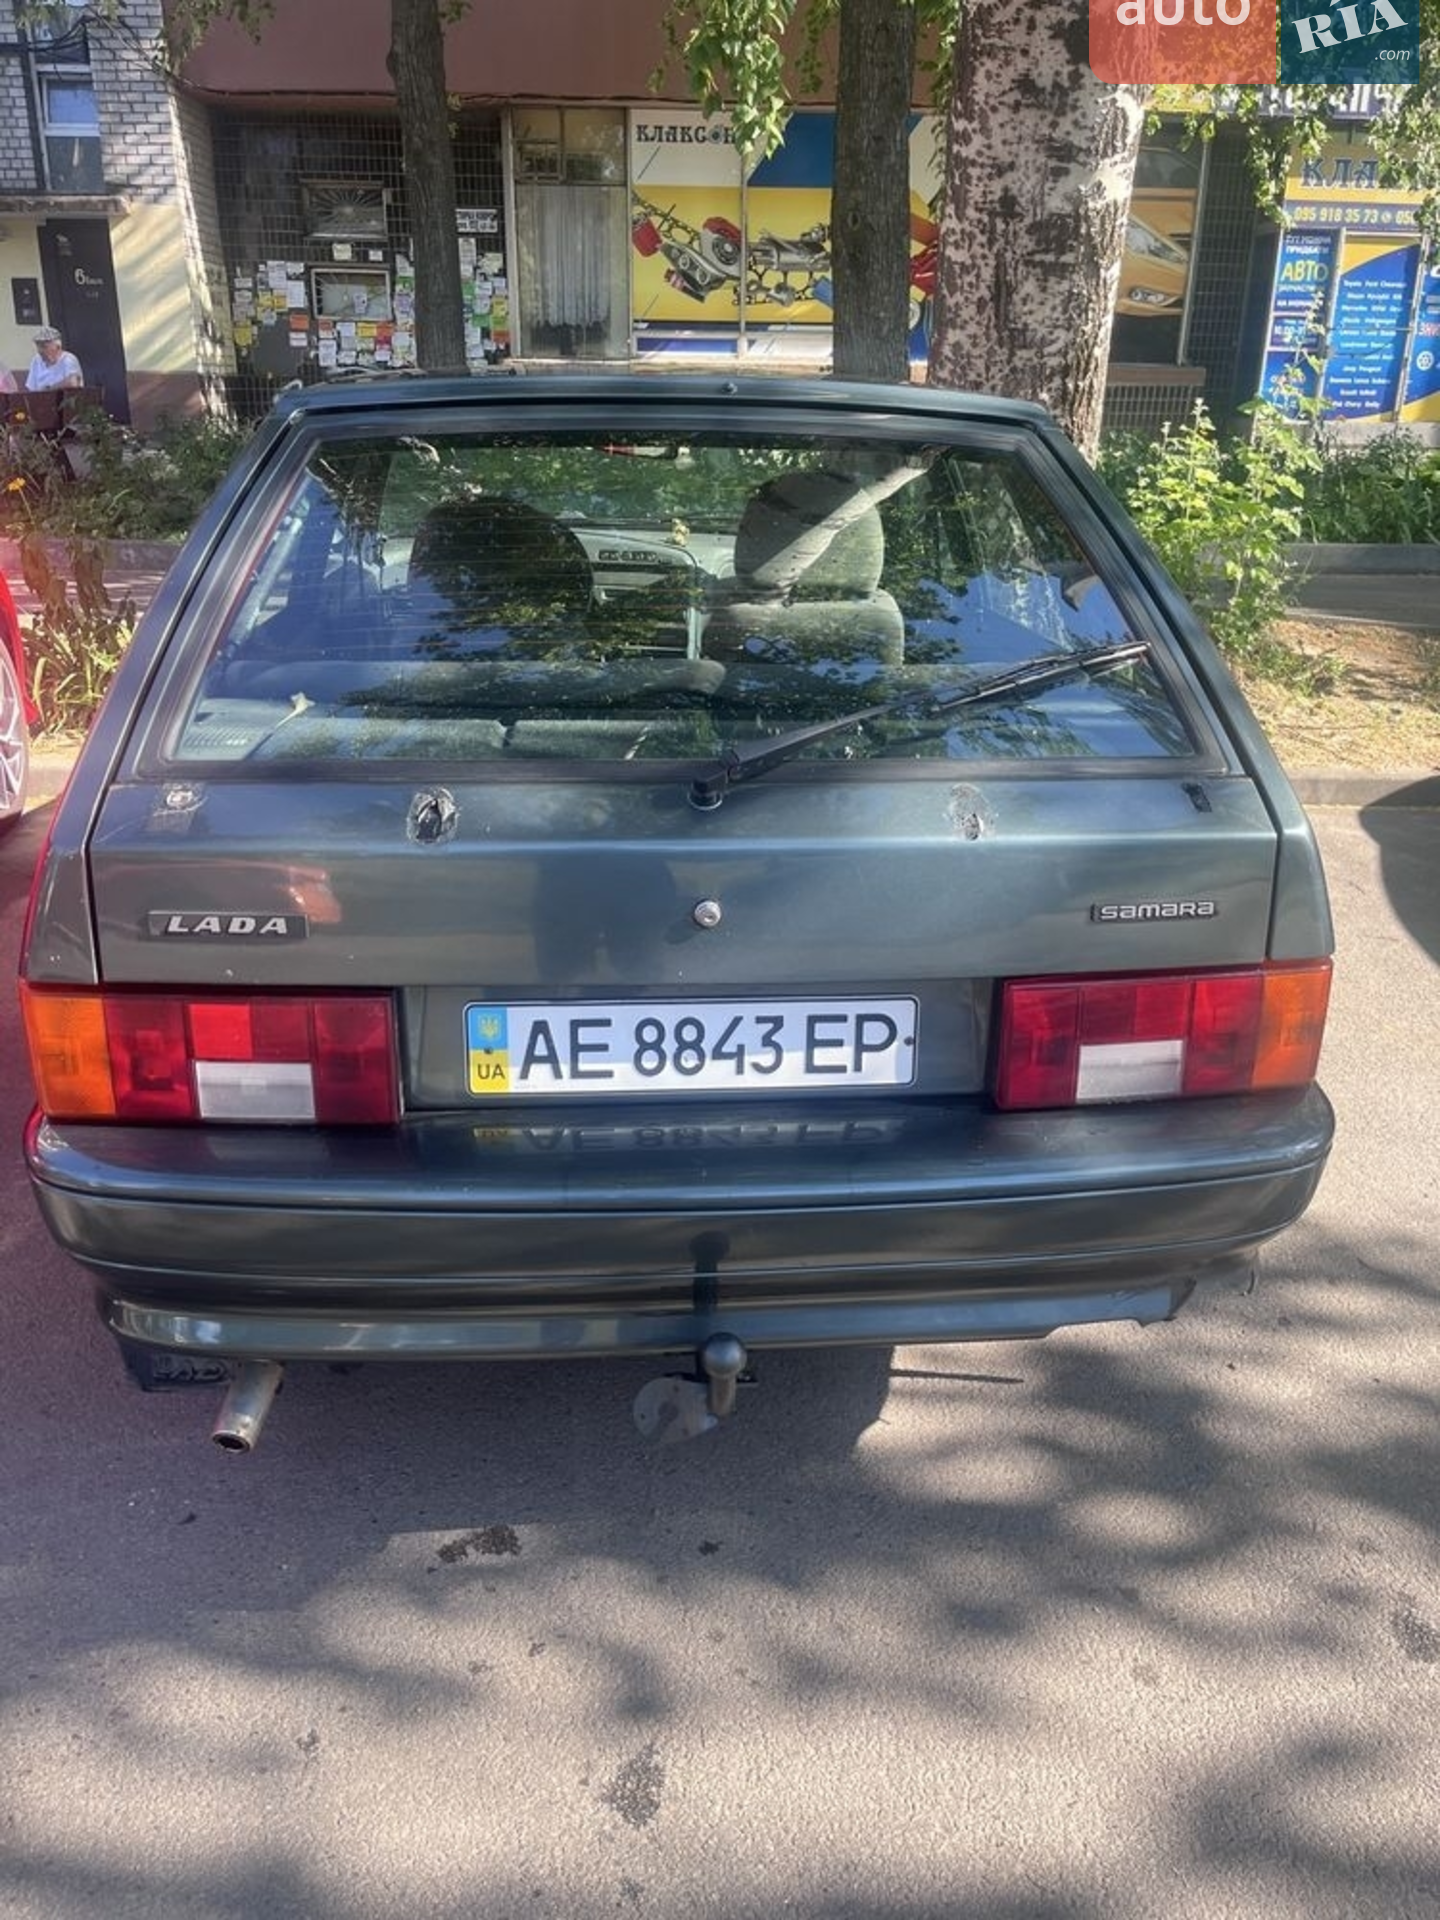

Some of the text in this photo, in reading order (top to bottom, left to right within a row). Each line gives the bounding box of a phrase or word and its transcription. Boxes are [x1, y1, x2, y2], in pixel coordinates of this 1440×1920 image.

[1280, 260, 1329, 281] АВТО
[167, 915, 288, 935] LADA
[519, 1013, 898, 1081] AE 8843 EP
[477, 1063, 506, 1080] UA
